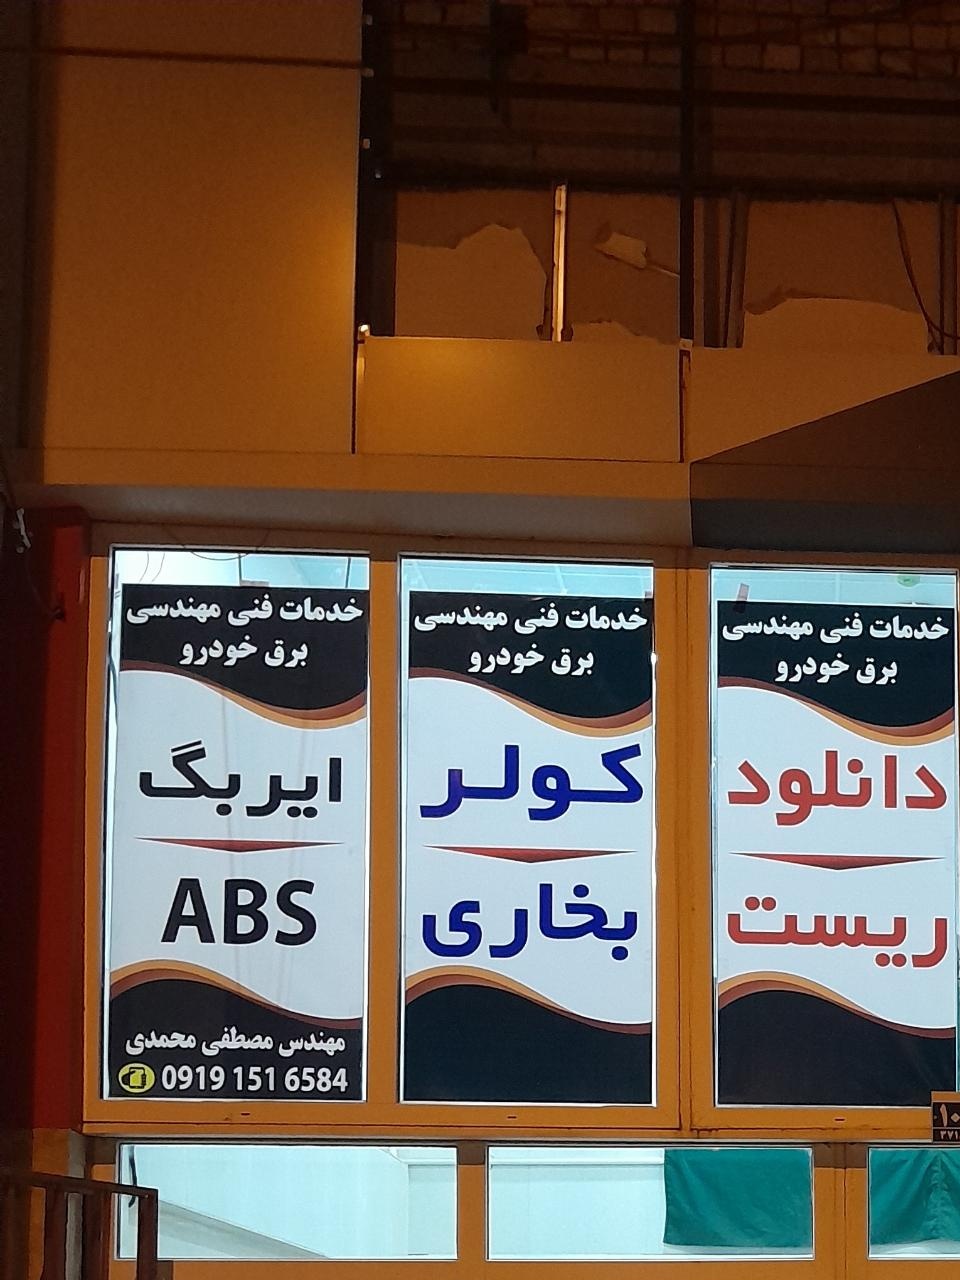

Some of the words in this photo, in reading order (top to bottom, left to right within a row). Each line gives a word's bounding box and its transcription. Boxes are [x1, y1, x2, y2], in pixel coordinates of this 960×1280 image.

[127, 598, 220, 623] مهندسی
[228, 594, 272, 625] فنی
[280, 597, 363, 621] خدمات
[415, 606, 507, 631] مهندسی
[515, 603, 558, 634] فنی
[566, 606, 647, 629] خدمات
[723, 616, 813, 640] مهندسی
[820, 613, 862, 643] فنی
[870, 616, 949, 639] خدمات
[180, 635, 257, 665] خودرو
[265, 640, 307, 667] برق
[468, 644, 544, 673] خودرو
[552, 649, 593, 675] برق
[775, 653, 849, 682] خودرو
[857, 658, 897, 684] برق
[420, 744, 643, 821] کولر
[728, 750, 947, 825] دانلود
[161, 878, 316, 945] ABS
[423, 884, 637, 960] بخاری
[728, 897, 947, 967] ریست
[126, 1031, 196, 1055] محمدی
[202, 1027, 273, 1055] مصطفی
[279, 1032, 345, 1056] مهندس
[162, 1065, 224, 1090] 0919
[234, 1067, 274, 1090] 151
[285, 1067, 347, 1091] 6584
